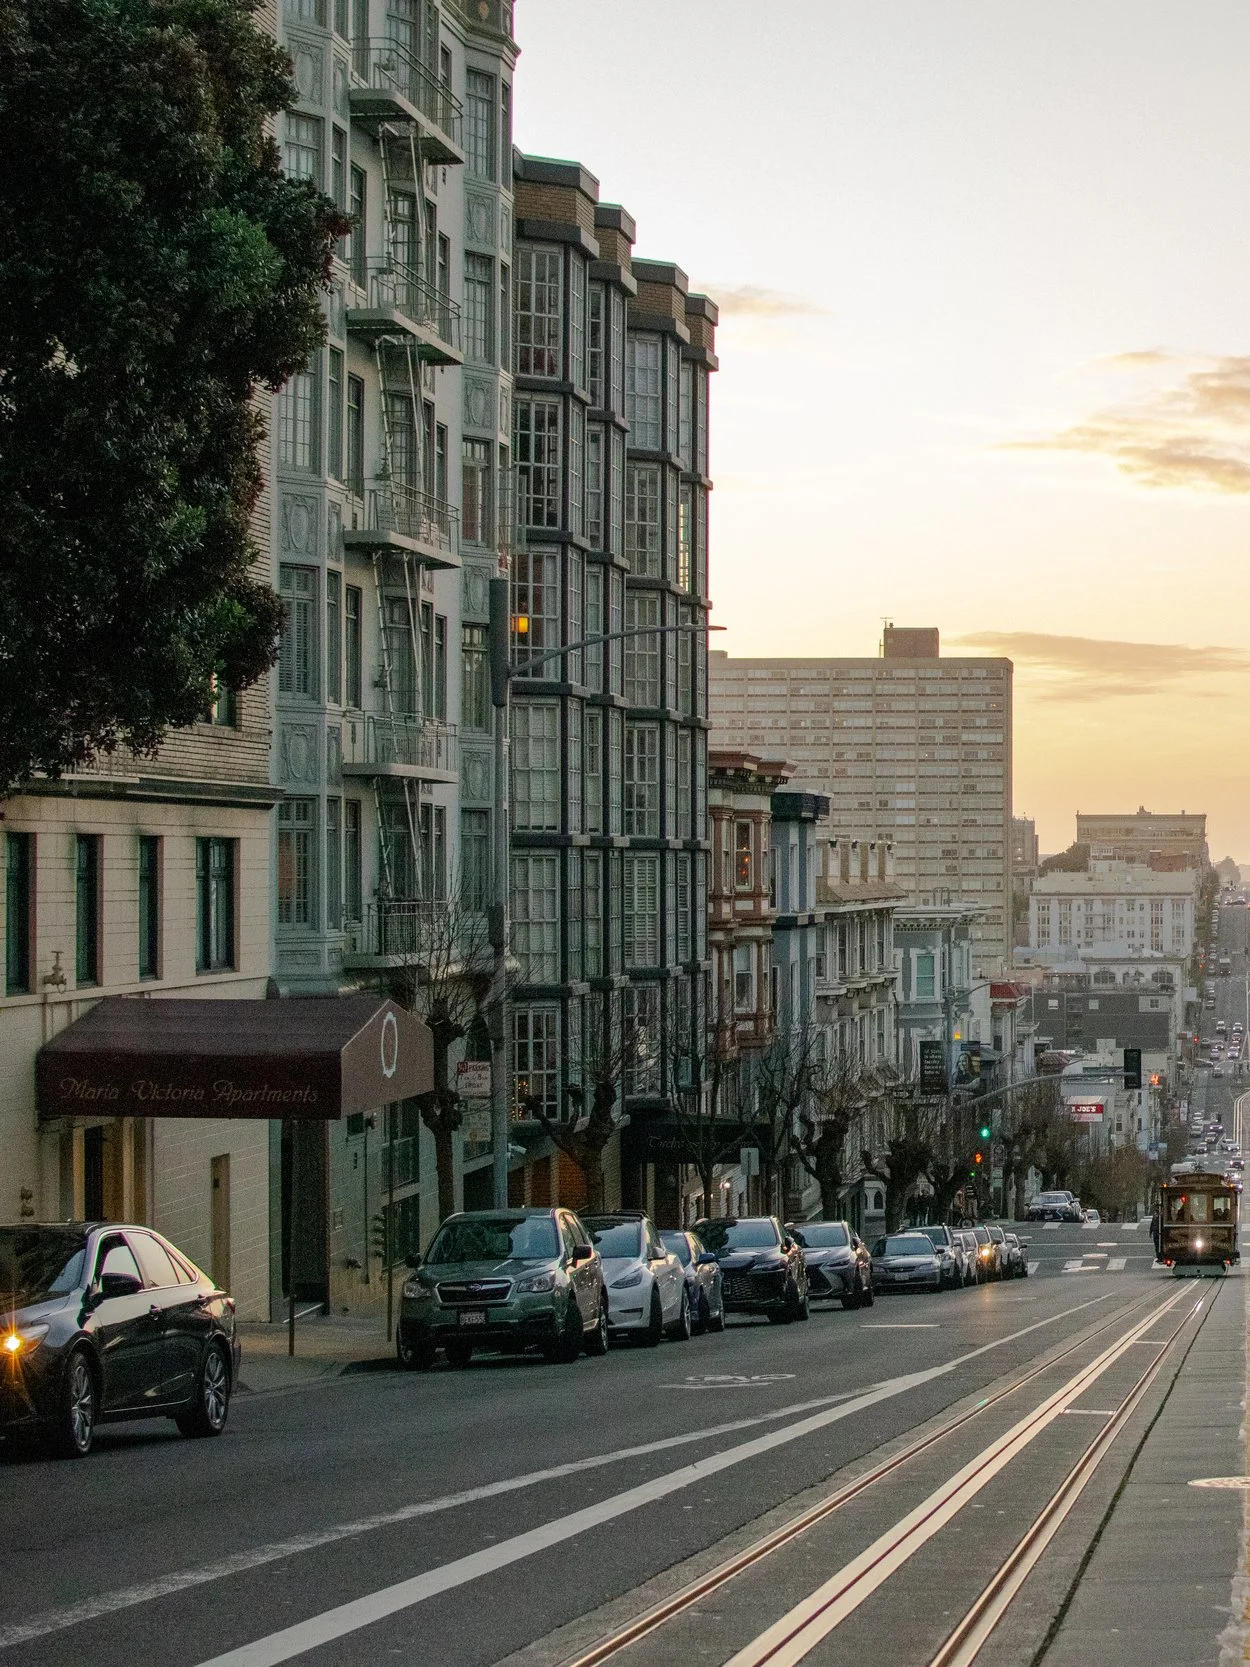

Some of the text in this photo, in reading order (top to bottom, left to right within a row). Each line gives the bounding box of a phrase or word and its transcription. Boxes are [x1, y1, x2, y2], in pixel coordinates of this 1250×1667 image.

[60, 1077, 318, 1106] Maria Victoria Apartments
